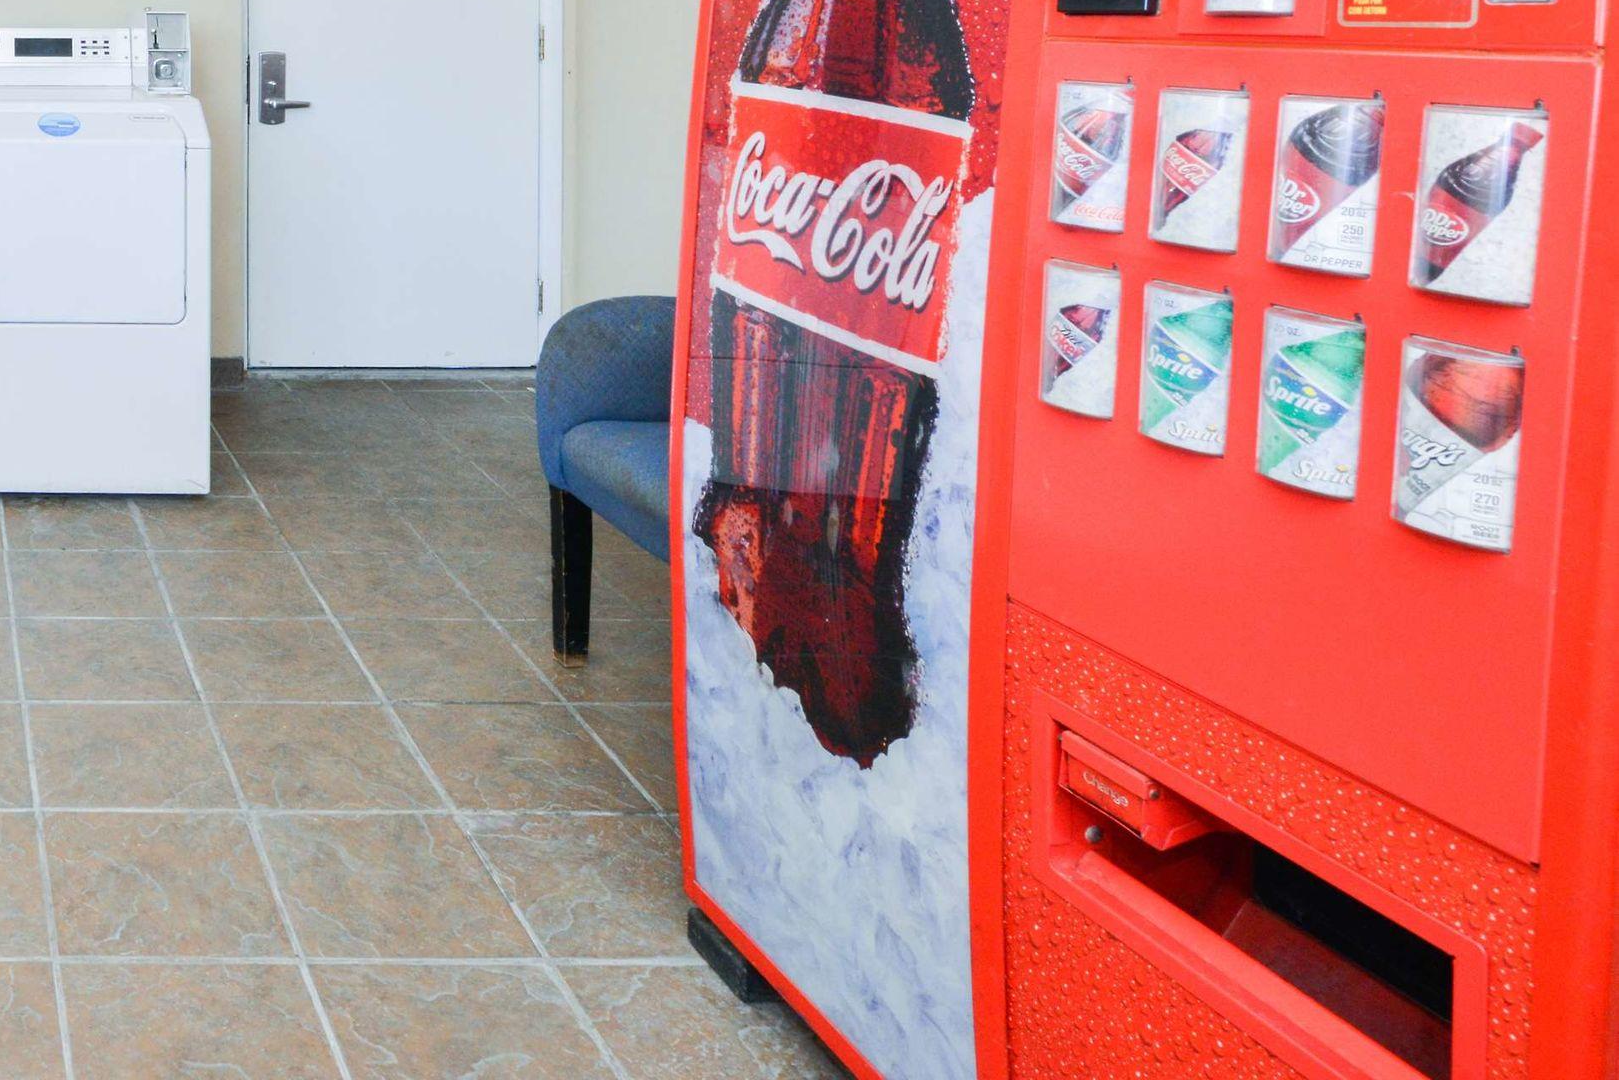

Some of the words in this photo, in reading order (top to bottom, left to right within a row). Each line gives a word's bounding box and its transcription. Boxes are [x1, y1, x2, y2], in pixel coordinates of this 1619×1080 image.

[1281, 178, 1306, 201] Dr
[727, 131, 954, 311] Coca-Cola
[1342, 224, 1365, 236] 250
[1303, 254, 1319, 264] DR
[1321, 256, 1363, 270] PEPPER
[1149, 344, 1203, 380] Sprite
[1266, 374, 1332, 416] Sprite
[1402, 428, 1466, 471] arq's
[1473, 472, 1490, 486] 20
[1474, 492, 1500, 506] 270
[1082, 771, 1129, 808] Change
